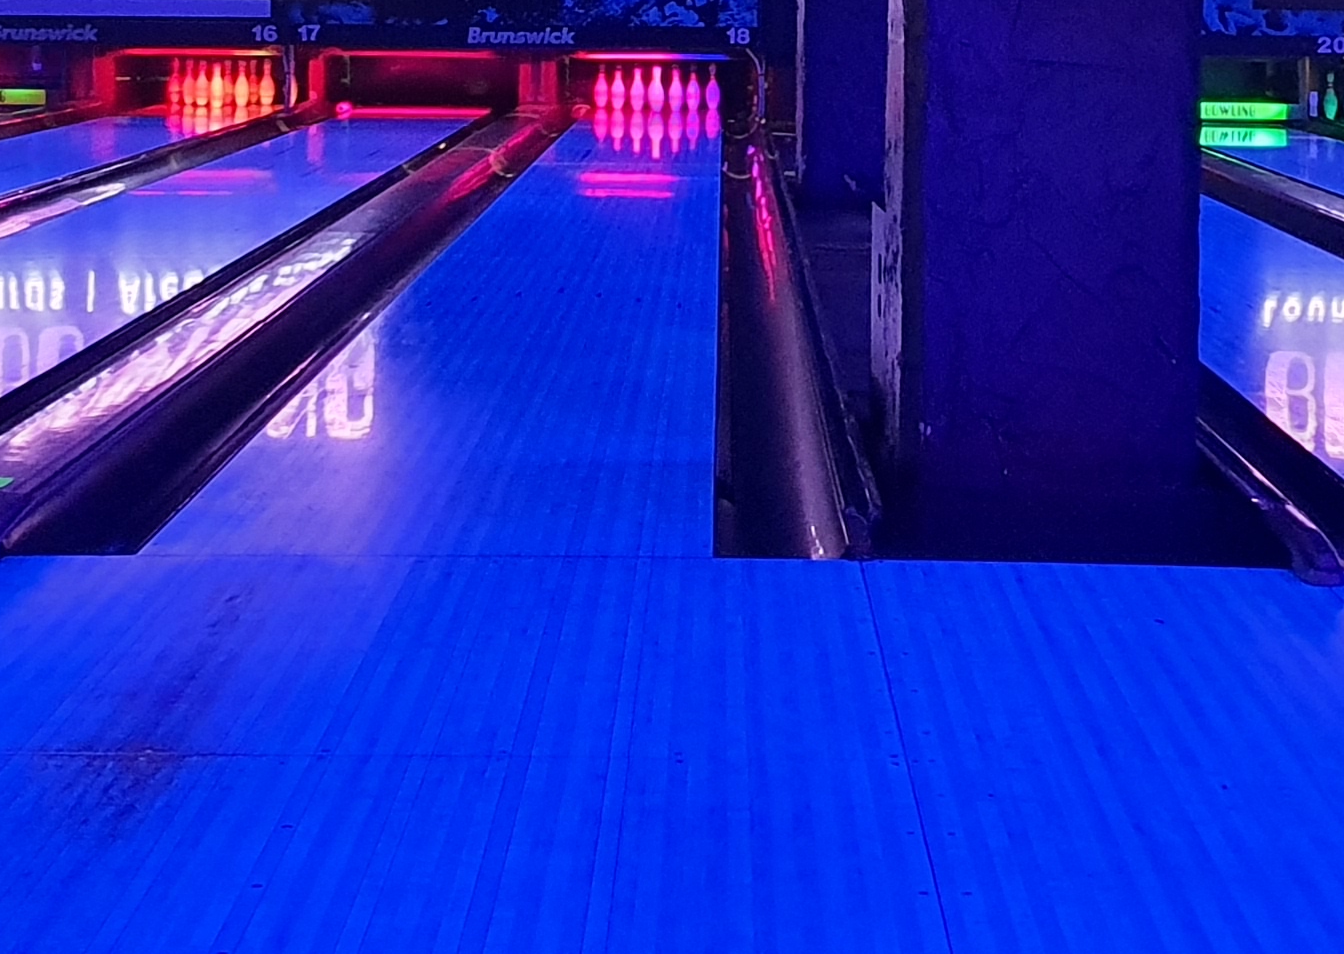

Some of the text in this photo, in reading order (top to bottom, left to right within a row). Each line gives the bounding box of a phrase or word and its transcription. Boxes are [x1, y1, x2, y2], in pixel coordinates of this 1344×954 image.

[251, 25, 278, 42] 16
[298, 25, 321, 41] 17
[467, 26, 575, 44] Brunswick
[726, 27, 751, 44] 18
